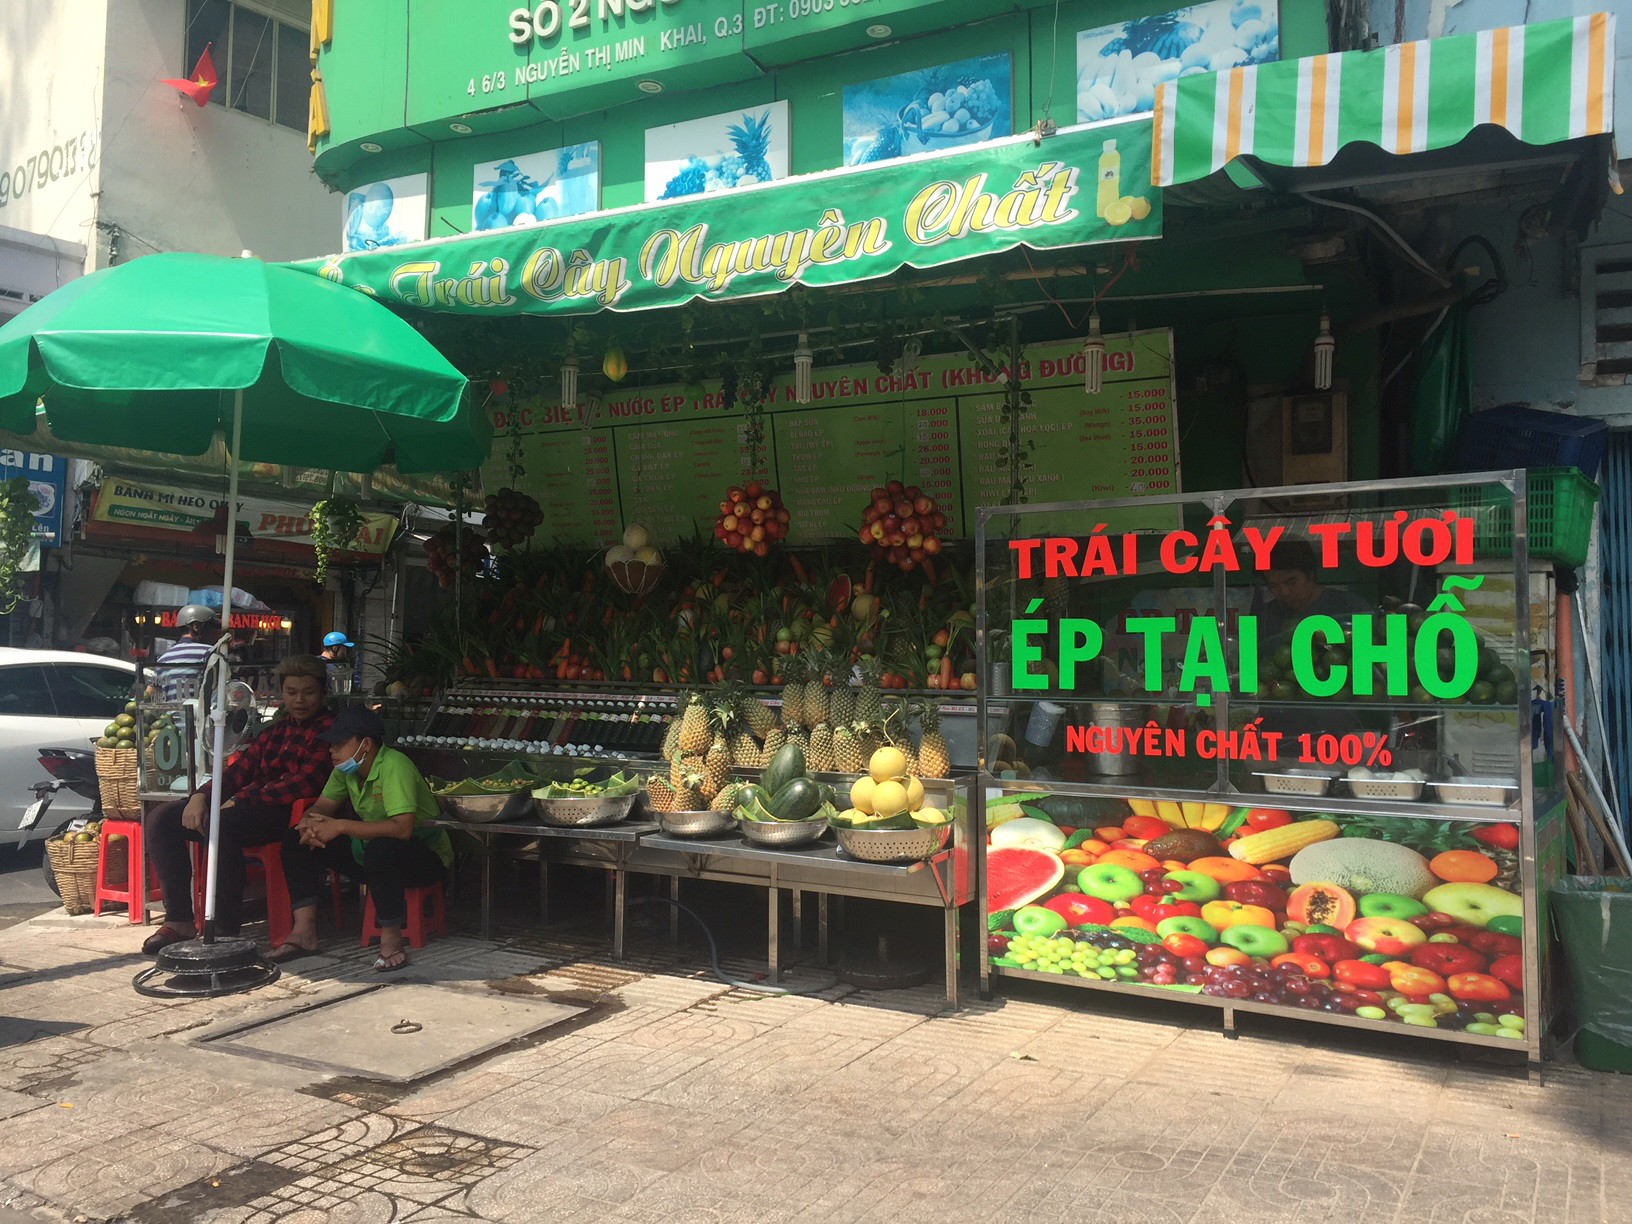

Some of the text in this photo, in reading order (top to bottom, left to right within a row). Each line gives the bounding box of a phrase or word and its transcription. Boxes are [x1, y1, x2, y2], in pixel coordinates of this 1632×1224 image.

[482, 71, 506, 93] 6/3
[514, 47, 580, 86] NGUYỄN
[585, 45, 612, 70] THỊ
[614, 36, 646, 63] MIN
[714, 14, 743, 40] Q.3
[390, 256, 516, 308] Trái
[520, 247, 632, 308] Cây
[638, 207, 893, 294] Nguyên
[903, 161, 1080, 247] Chất
[608, 394, 657, 418] NƯỚC
[661, 389, 687, 414] ÉP
[785, 375, 869, 402] NUYÊN
[875, 366, 934, 394] CHẤT
[1127, 388, 1166, 399] 15.000
[1128, 401, 1167, 412] 15.000
[1084, 420, 1111, 430] (Mango)
[1128, 414, 1167, 426] 35.000
[1129, 427, 1168, 439] 15.000
[1130, 440, 1169, 452] 15.000
[1131, 453, 1169, 464] 20.000
[1131, 466, 1170, 478] 20.000
[1092, 485, 1115, 494] (Kiwi)
[177, 495, 206, 508] HEO
[1009, 510, 1474, 579] TRÁI CÂY TƯƠI
[1012, 598, 1103, 690] ÉP
[1126, 615, 1258, 707] TẠI
[1291, 575, 1484, 699] CHỖ
[1067, 717, 1392, 766] NGUYÊN CHẤT 100%
